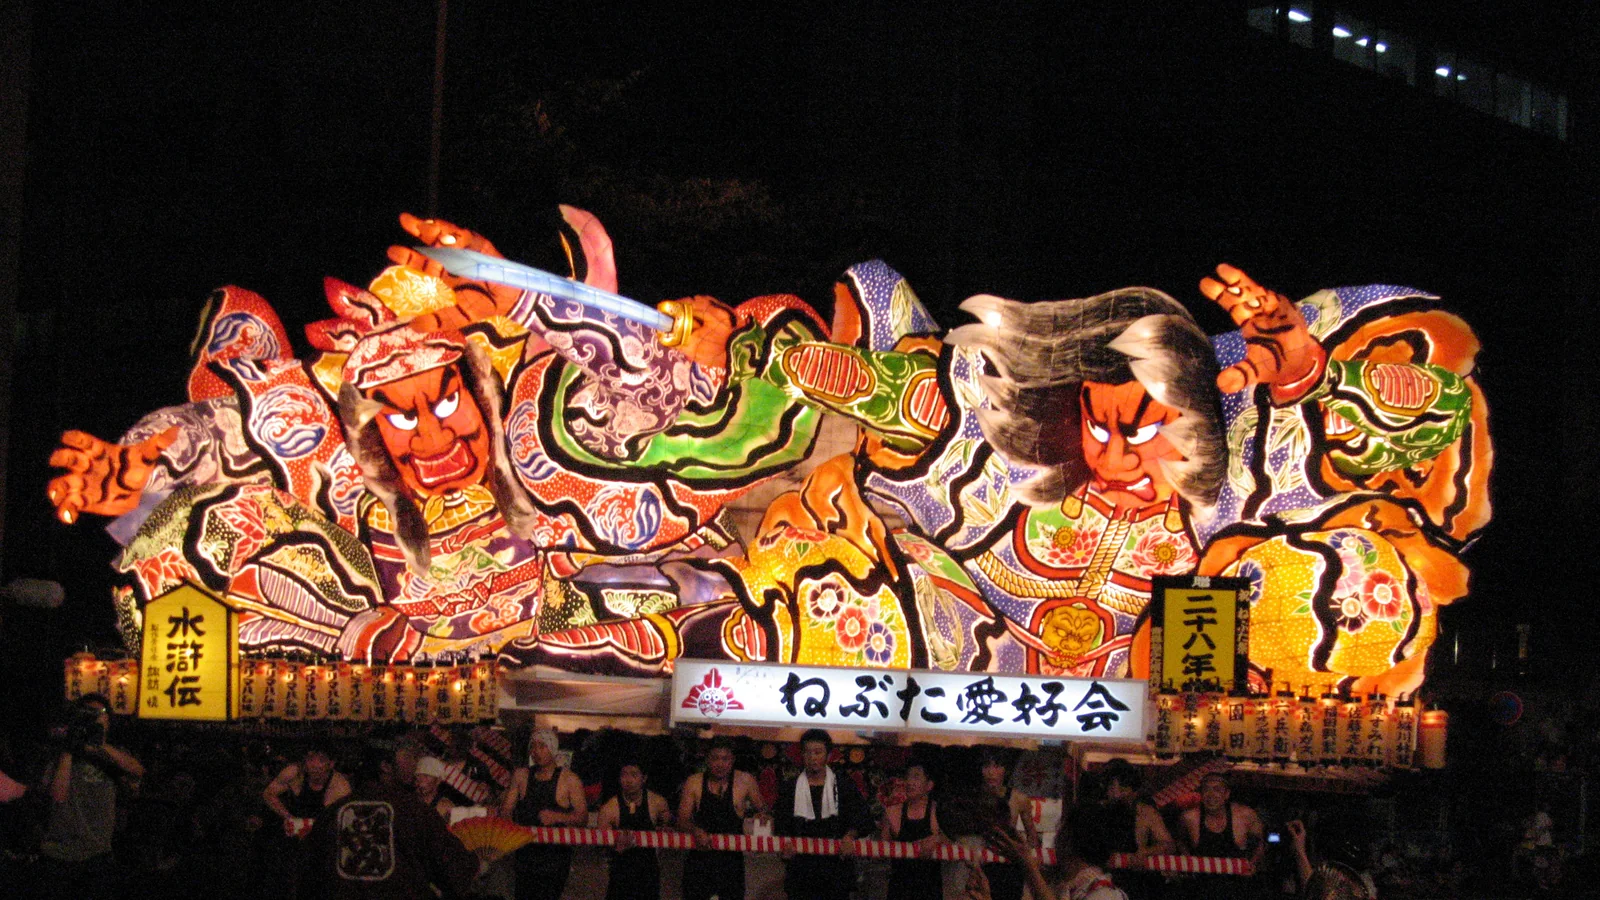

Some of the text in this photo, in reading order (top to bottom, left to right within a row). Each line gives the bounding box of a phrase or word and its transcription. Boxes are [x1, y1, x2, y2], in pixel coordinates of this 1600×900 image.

[164, 606, 206, 708] 水滸伝
[778, 671, 1131, 733] ねぶた愛好会
